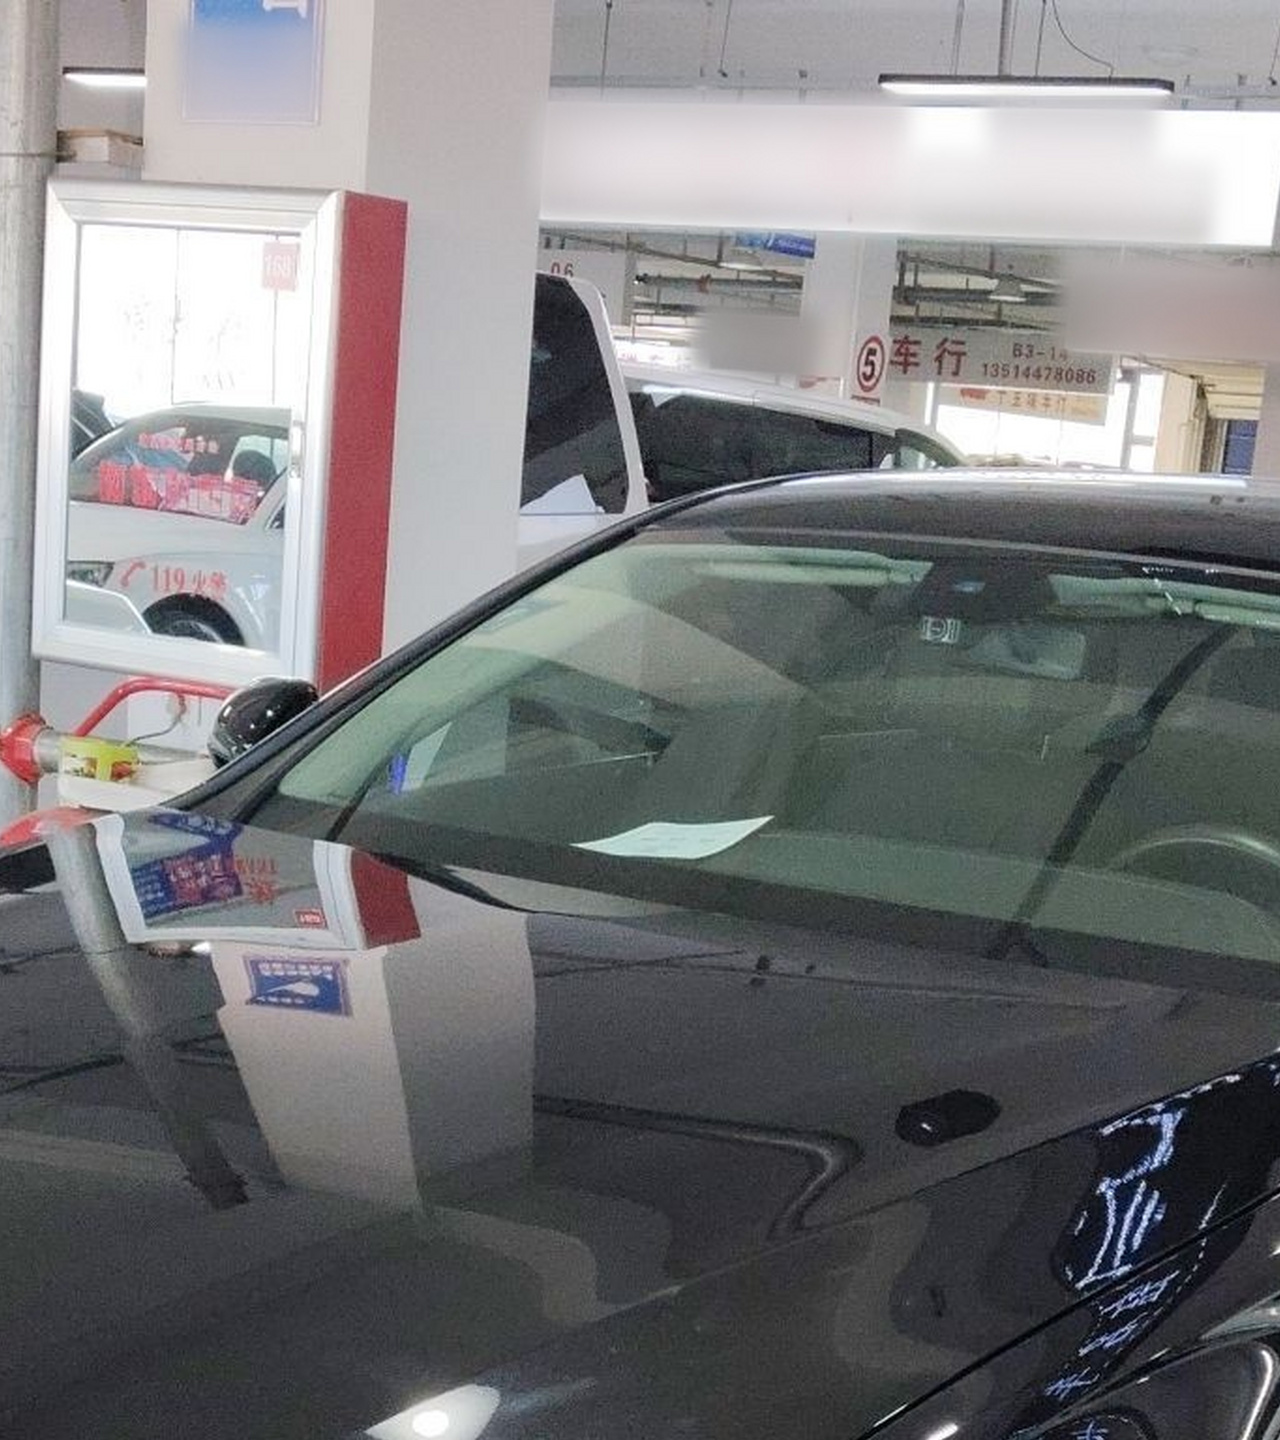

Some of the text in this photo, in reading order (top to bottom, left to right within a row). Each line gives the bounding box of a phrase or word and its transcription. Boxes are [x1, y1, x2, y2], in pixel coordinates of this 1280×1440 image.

[889, 335, 968, 377] 车行
[981, 363, 1097, 385] 13514478086
[151, 562, 186, 592] 119
